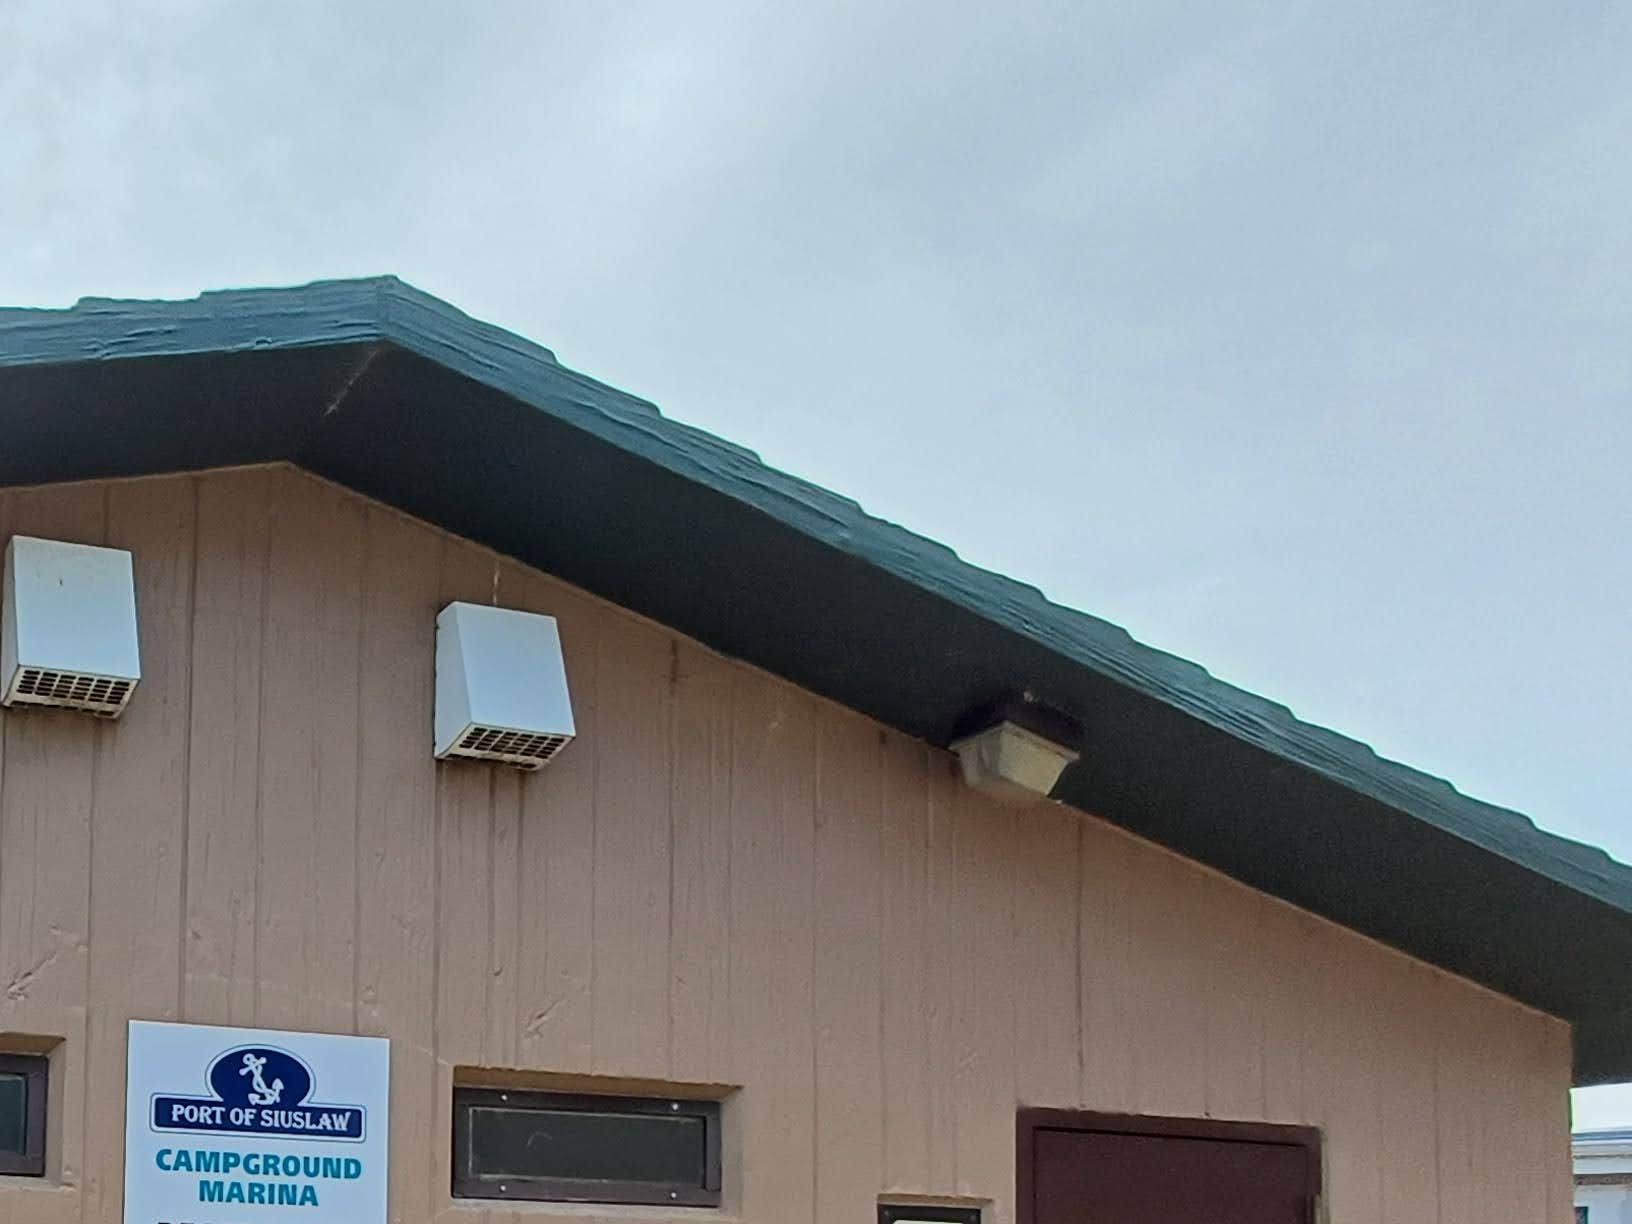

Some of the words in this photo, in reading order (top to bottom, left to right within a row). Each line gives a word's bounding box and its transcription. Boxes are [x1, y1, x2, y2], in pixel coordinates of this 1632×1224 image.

[171, 1104, 226, 1124] PORT
[230, 1106, 255, 1126] OF
[261, 1109, 352, 1132] SIUSLAW
[155, 1149, 362, 1179] CAMPGROUND
[199, 1180, 319, 1206] MARINA
